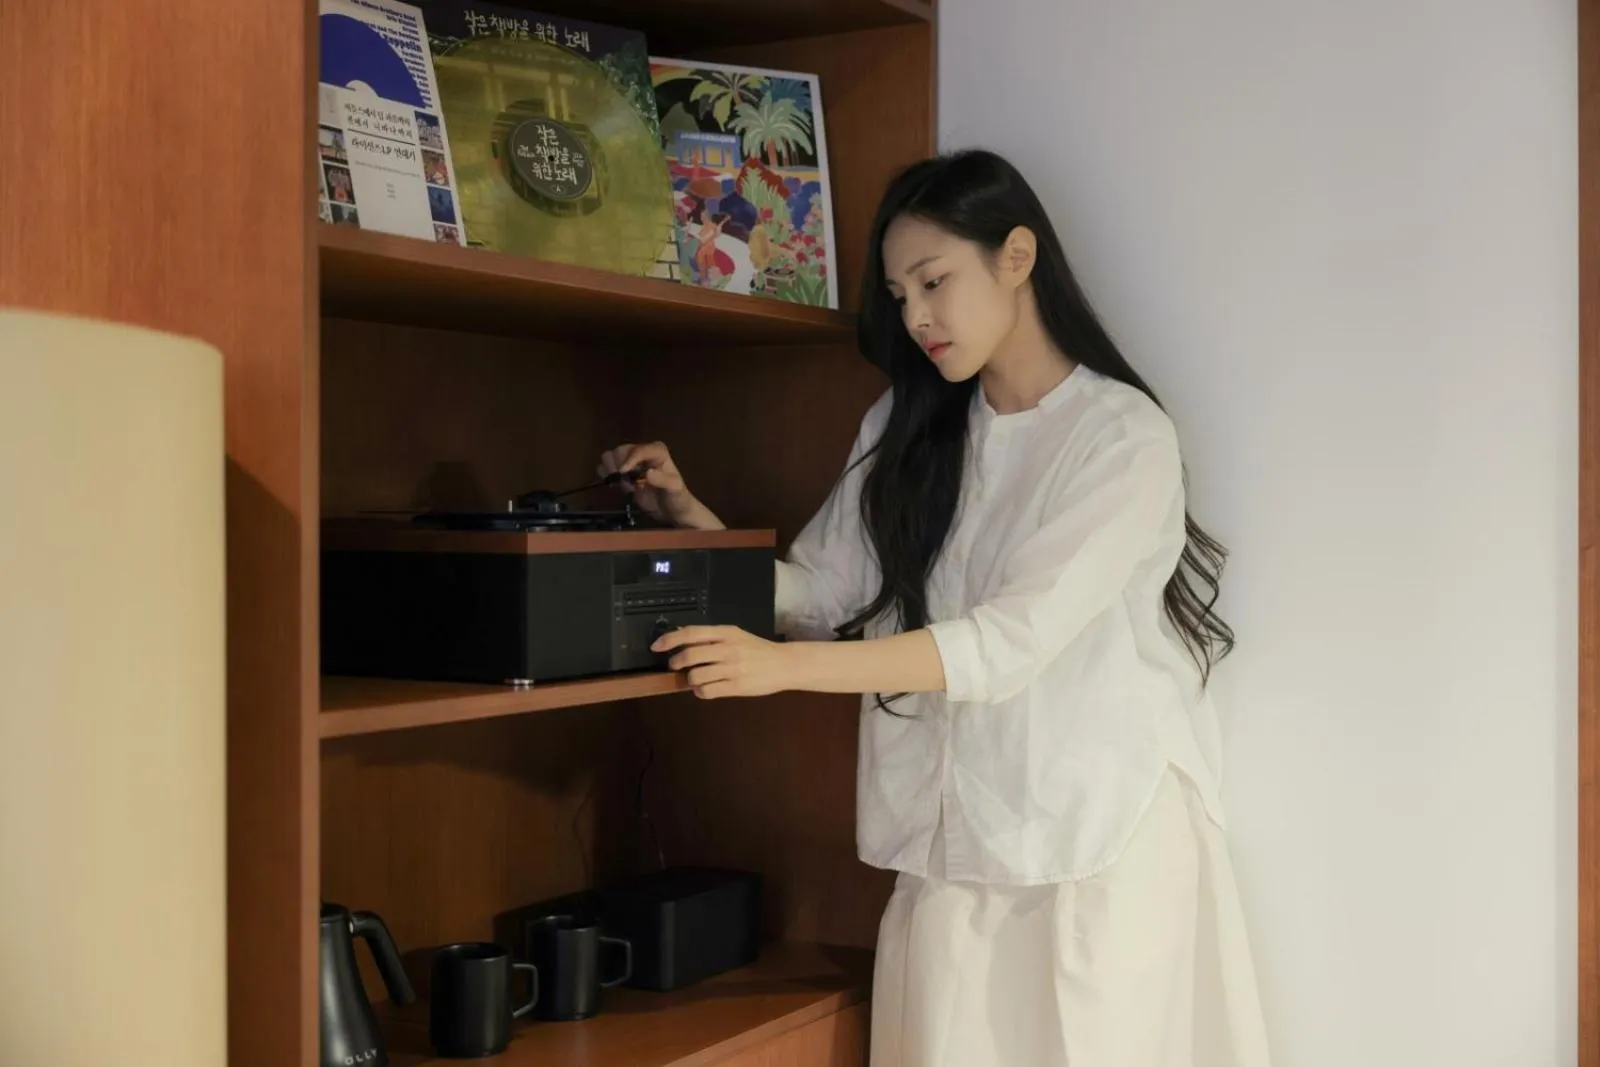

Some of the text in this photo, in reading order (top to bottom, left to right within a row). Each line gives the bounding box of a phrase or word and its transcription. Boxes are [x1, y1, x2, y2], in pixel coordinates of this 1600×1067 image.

[464, 10, 591, 52] 작은 책방을 위한 노래
[383, 33, 423, 53] Zeppelin
[535, 125, 559, 146] 작은
[534, 143, 570, 165] 책방을
[532, 162, 577, 185] 위한 노래
